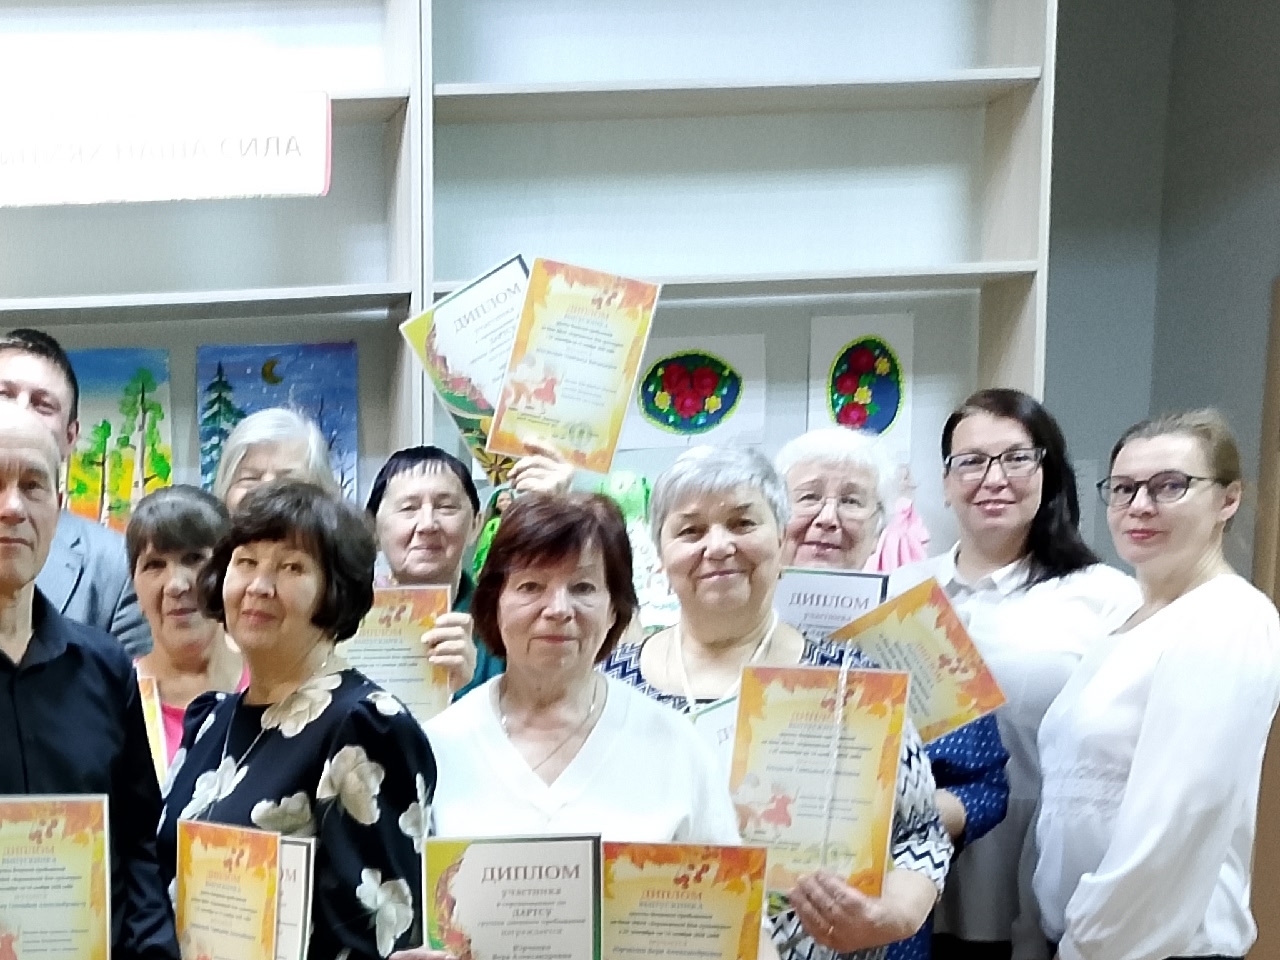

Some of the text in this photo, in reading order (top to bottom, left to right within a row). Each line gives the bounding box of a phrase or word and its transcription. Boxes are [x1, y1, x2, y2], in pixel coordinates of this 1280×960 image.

[217, 134, 304, 161] СИЛА
[454, 282, 522, 334] ДИПЛОМ
[789, 592, 870, 610] ДИПЛОМ
[481, 863, 581, 885] ДИПЛОМ
